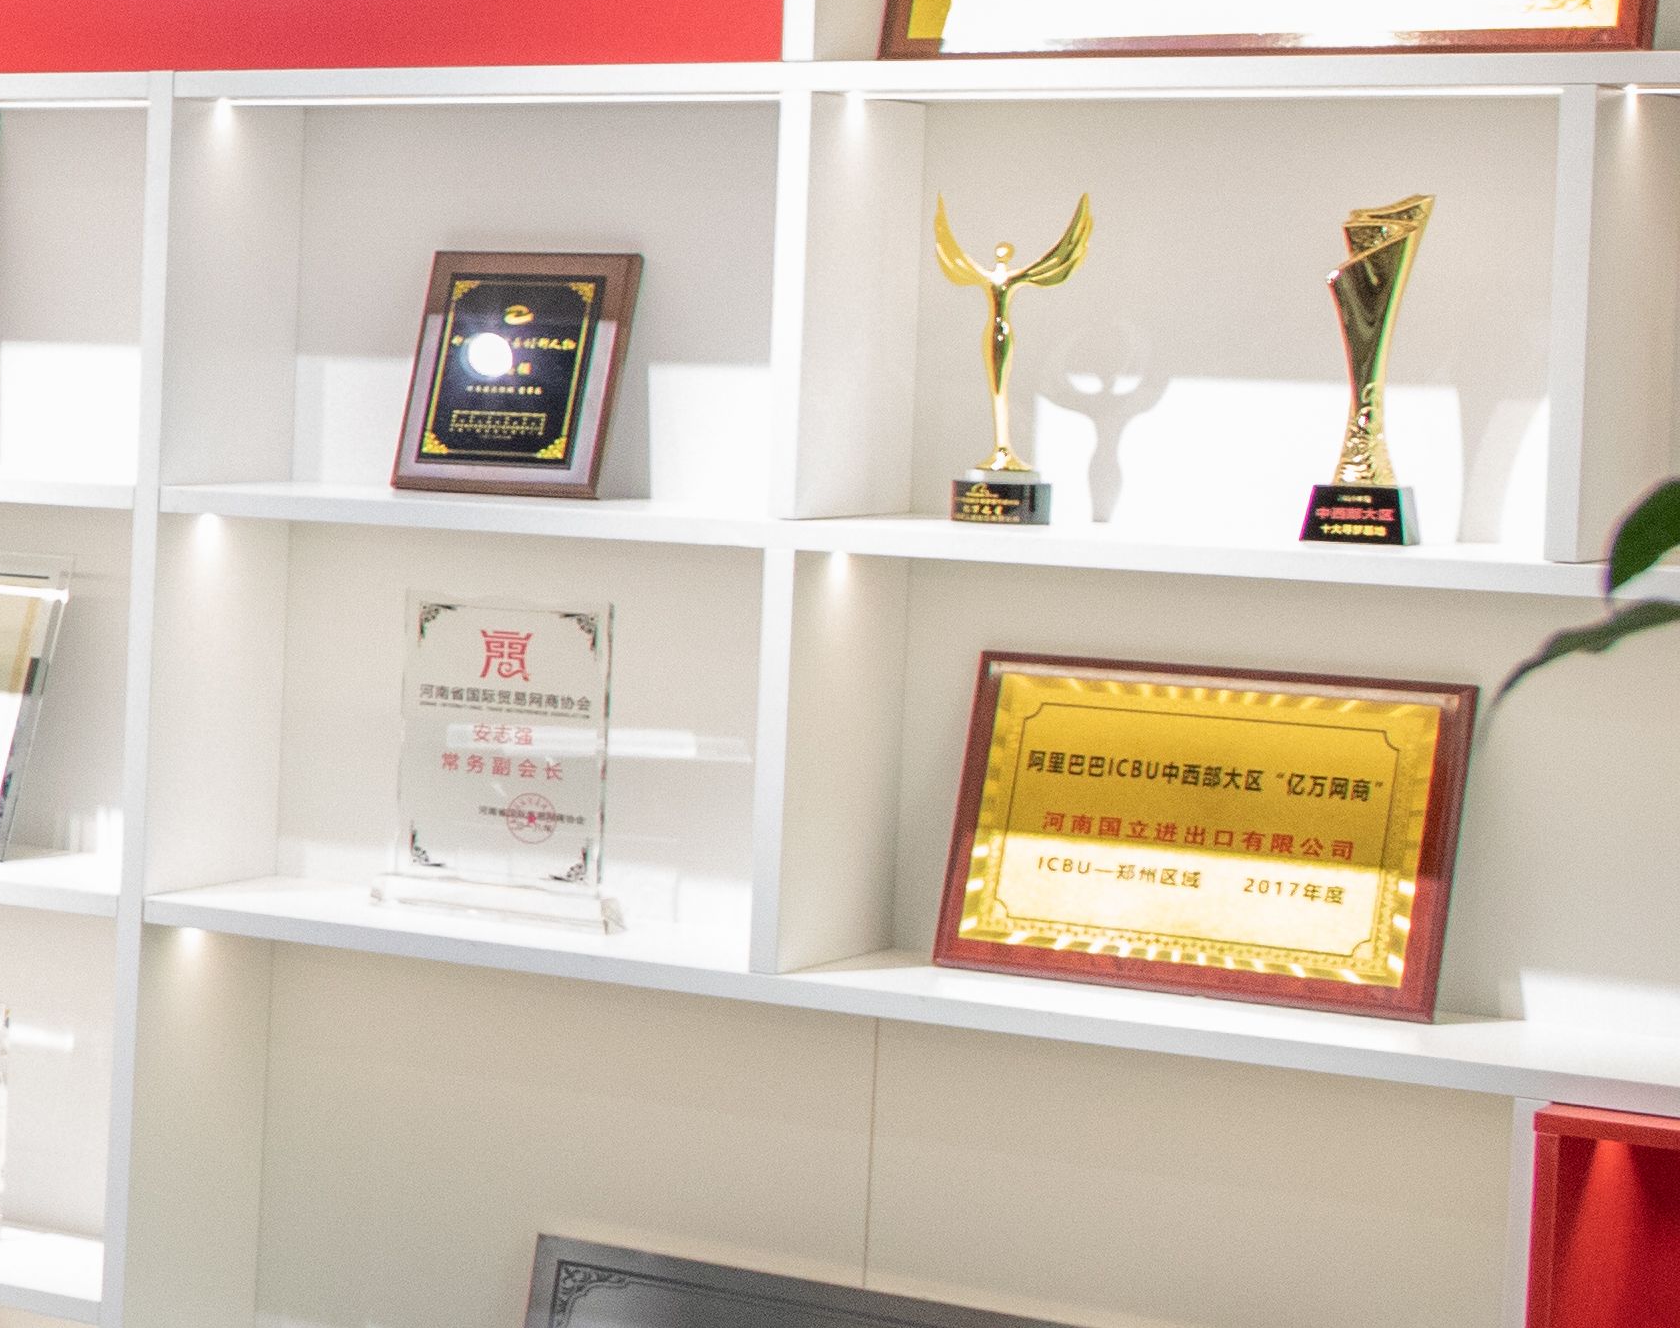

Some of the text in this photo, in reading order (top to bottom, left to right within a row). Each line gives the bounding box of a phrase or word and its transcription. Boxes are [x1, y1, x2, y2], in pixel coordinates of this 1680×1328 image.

[419, 683, 592, 712] 河南省国际贸易网商协会
[472, 722, 534, 746] 安志强
[441, 752, 563, 782] 常务副会长
[1041, 809, 1356, 861] 河南国立进出口有限公司
[1243, 876, 1346, 906] 2017年度
